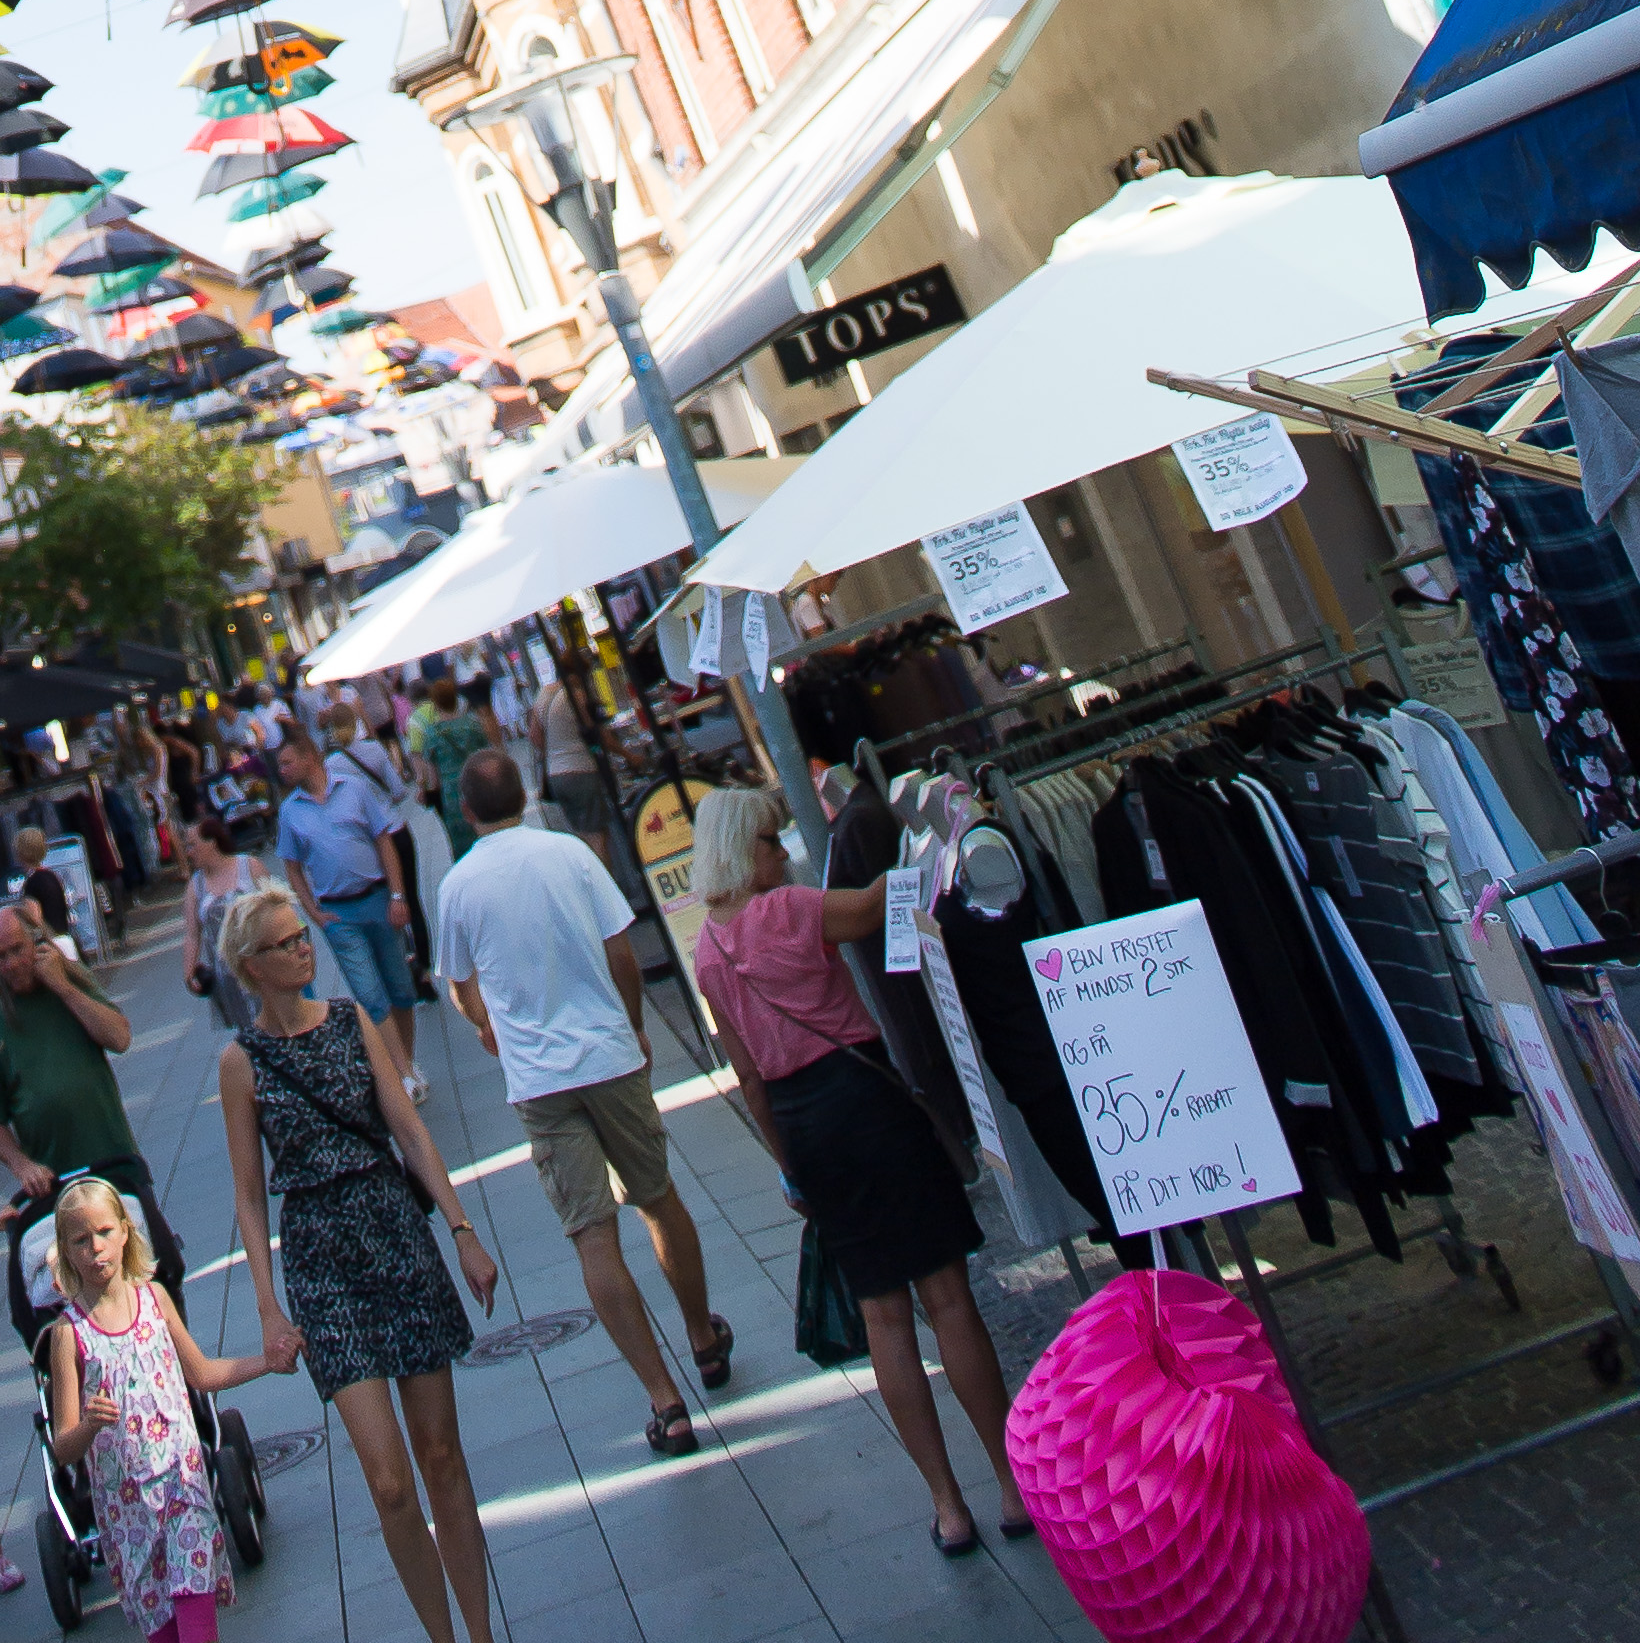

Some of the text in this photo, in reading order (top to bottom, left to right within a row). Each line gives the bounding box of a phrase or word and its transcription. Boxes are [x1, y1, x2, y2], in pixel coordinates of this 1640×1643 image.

[784, 286, 930, 364] TOPS
[1199, 454, 1251, 482] 35%
[948, 547, 1000, 582] 35%
[1111, 929, 1179, 964] FRISTET
[1045, 987, 1068, 1013] AF
[1075, 972, 1134, 1003] MINDST
[1141, 957, 1172, 997] 2
[1062, 1023, 1112, 1066] OG FÅ
[1186, 1086, 1238, 1122] RABAT
[1112, 1169, 1143, 1216] PÅ
[1148, 1175, 1181, 1207] DIT
